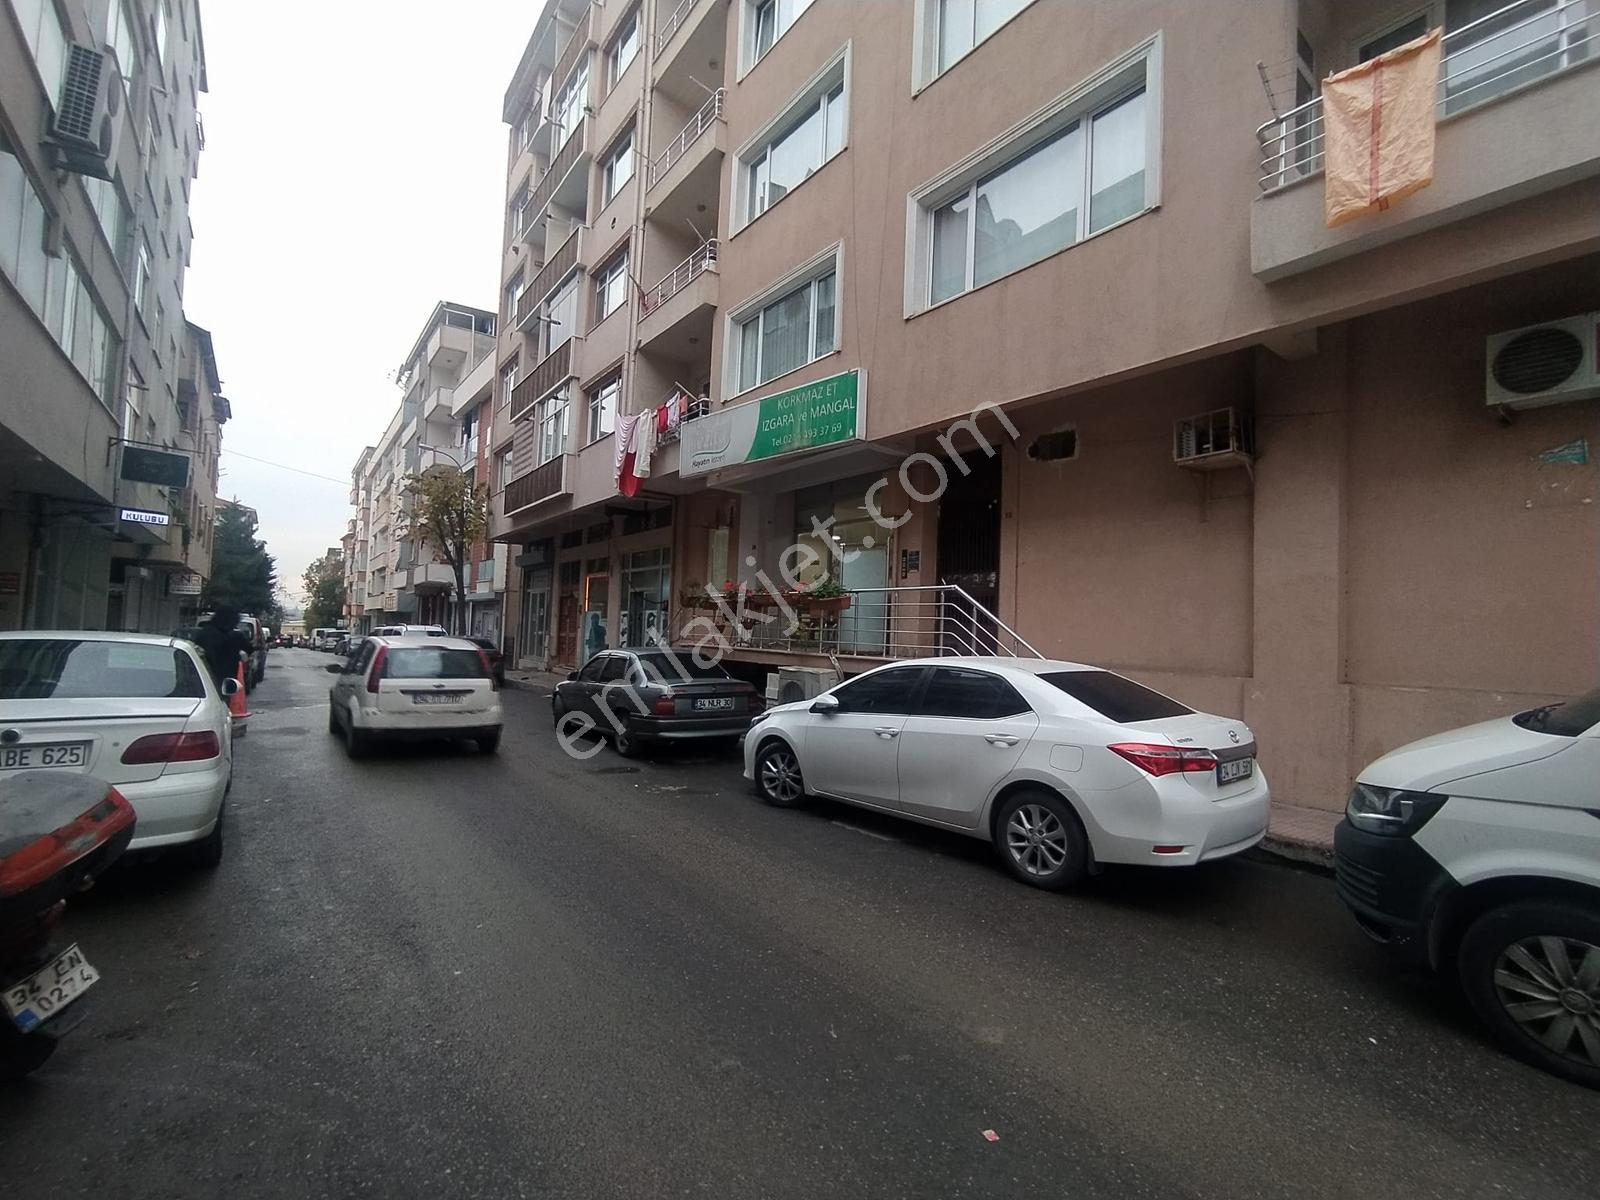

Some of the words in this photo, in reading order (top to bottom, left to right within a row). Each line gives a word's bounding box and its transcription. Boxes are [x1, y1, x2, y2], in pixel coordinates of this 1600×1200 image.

[777, 386, 823, 411] KORKMAZ
[826, 382, 838, 396] ET
[810, 398, 855, 418] MANGAL
[820, 424, 830, 436] 37
[831, 421, 842, 433] 69
[0, 749, 32, 768] BE
[41, 747, 81, 765] 625
